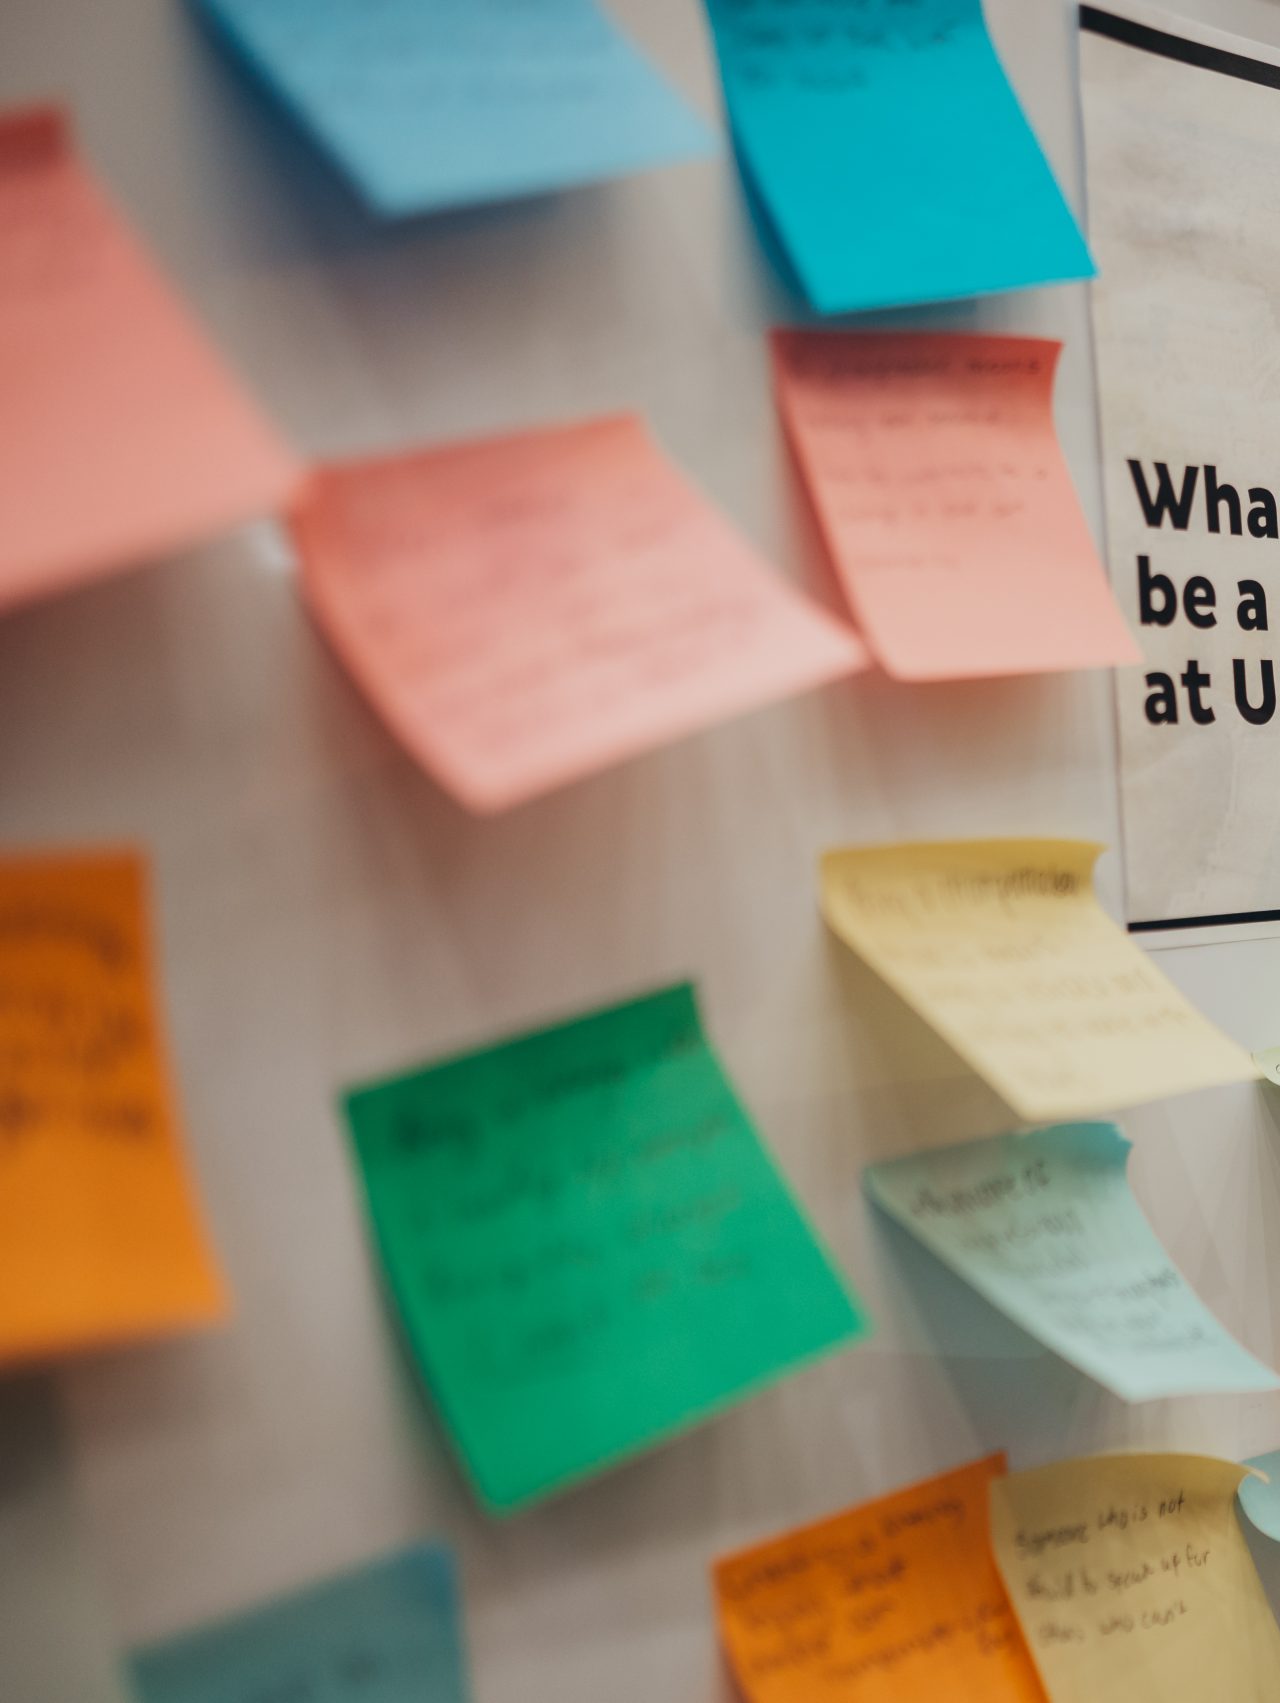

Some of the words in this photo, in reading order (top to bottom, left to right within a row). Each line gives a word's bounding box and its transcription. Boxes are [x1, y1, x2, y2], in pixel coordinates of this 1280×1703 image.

[1137, 555, 1218, 630] be
[1237, 579, 1269, 632] a
[1144, 659, 1216, 726] at
[1158, 1488, 1186, 1518] not
